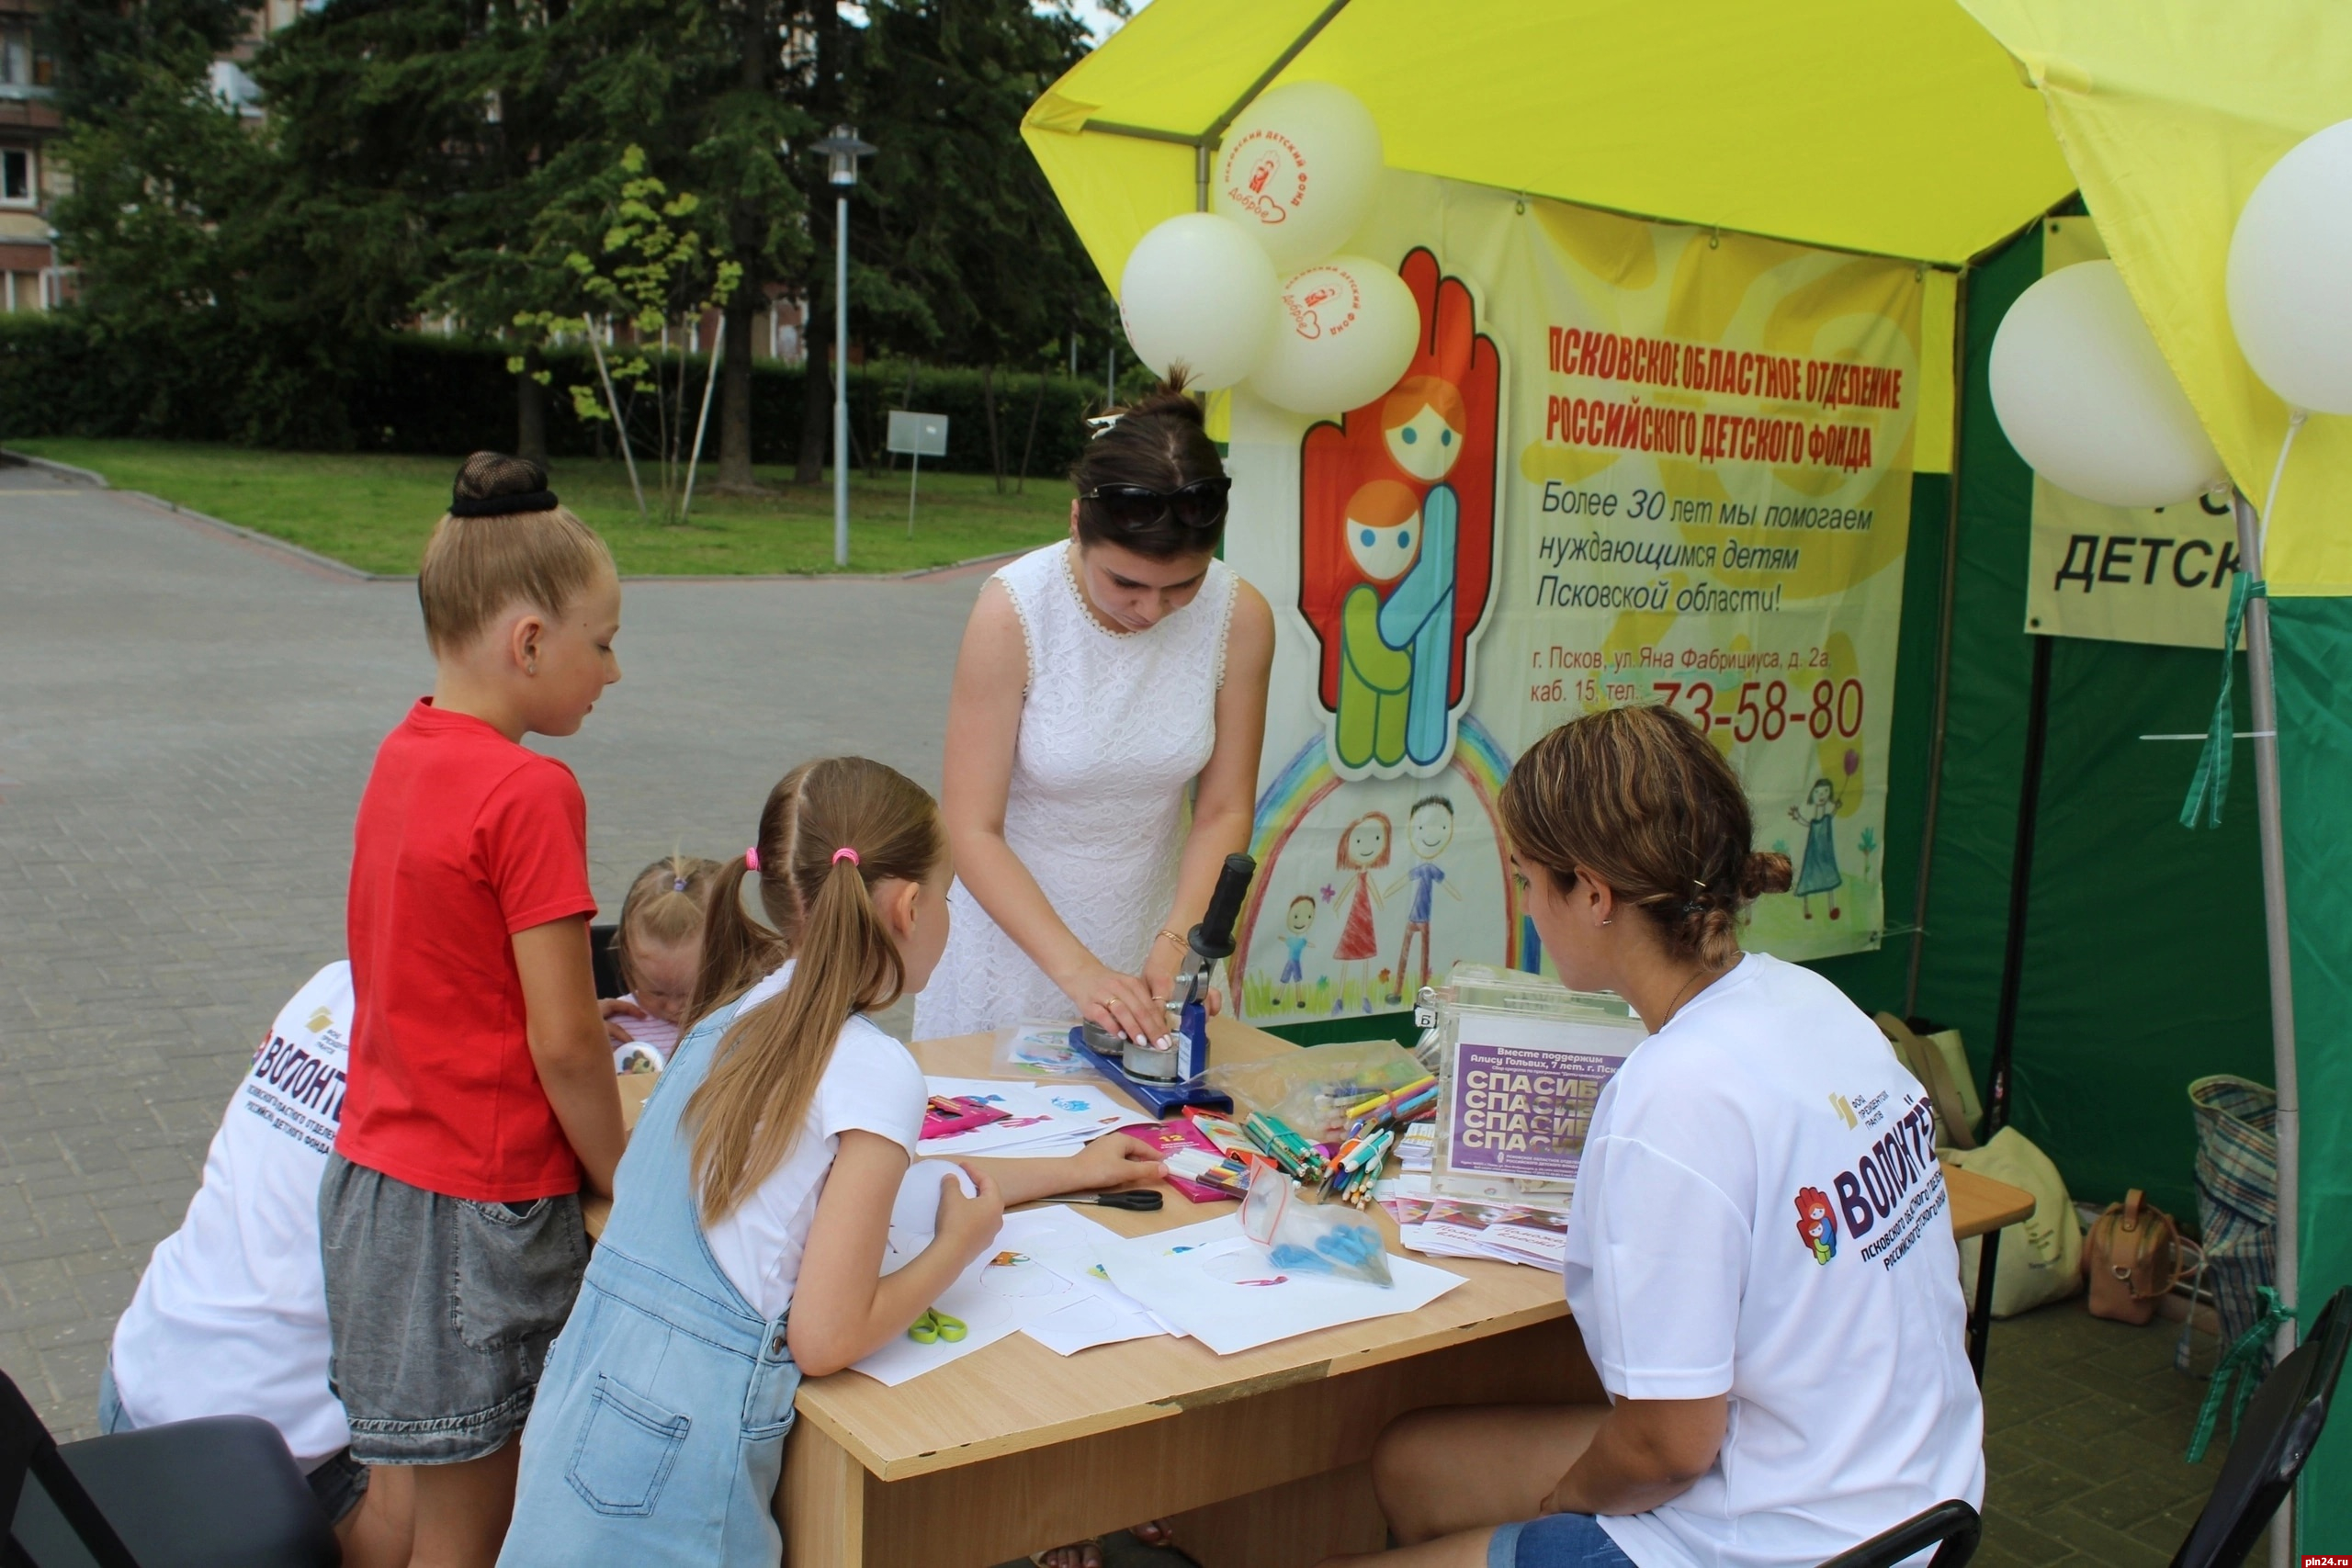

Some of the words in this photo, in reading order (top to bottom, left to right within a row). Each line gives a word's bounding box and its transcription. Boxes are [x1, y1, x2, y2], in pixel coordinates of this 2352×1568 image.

[1266, 130, 1306, 168] ДЕТСКИЙ
[1291, 172, 1307, 207] ФОНД
[1228, 186, 1269, 219] Доброе
[1329, 312, 1355, 335] ФОНД
[1549, 325, 1679, 387] ПСКОВСКОЕ
[1682, 344, 1802, 400] ОБЛАСТНОЕ
[1805, 359, 1903, 411] ОТДЕЛЕНИЕ
[1546, 394, 1697, 456] РОССИЙСКОГО
[1700, 412, 1804, 464] ДЕТСКОГО
[1808, 424, 1872, 474] ФОНДА
[1542, 480, 1618, 516] Более
[1626, 489, 1666, 521] 30
[1669, 499, 1713, 525] лет
[1718, 502, 1756, 527] мы
[1764, 504, 1873, 531] помогаем
[1539, 530, 1717, 570] нуждающимся
[1723, 538, 1800, 570] детям
[1536, 575, 1669, 611] Псковской
[1675, 582, 1782, 613] области!
[1532, 652, 1543, 670] г.
[1549, 646, 1608, 671] Псков,
[1613, 652, 1635, 674] ул.
[1639, 648, 1674, 670] Яна
[1680, 648, 1783, 675] Фабрициуса,
[1787, 653, 1804, 671] д.
[1530, 678, 1567, 702] каб.
[1575, 679, 1600, 703] 15,
[1470, 1054, 1503, 1066] Алису
[1505, 1058, 1549, 1069] Гольвих,
[1559, 1062, 1585, 1072] лет.
[1497, 1047, 1540, 1059] Вместе
[1542, 1051, 1603, 1064] поддержим
[1466, 1070, 1609, 1099] СПАСИБ
[304, 1135, 330, 1155] ФОНДА
[1860, 1217, 1905, 1262] ПСКОВСКОГО
